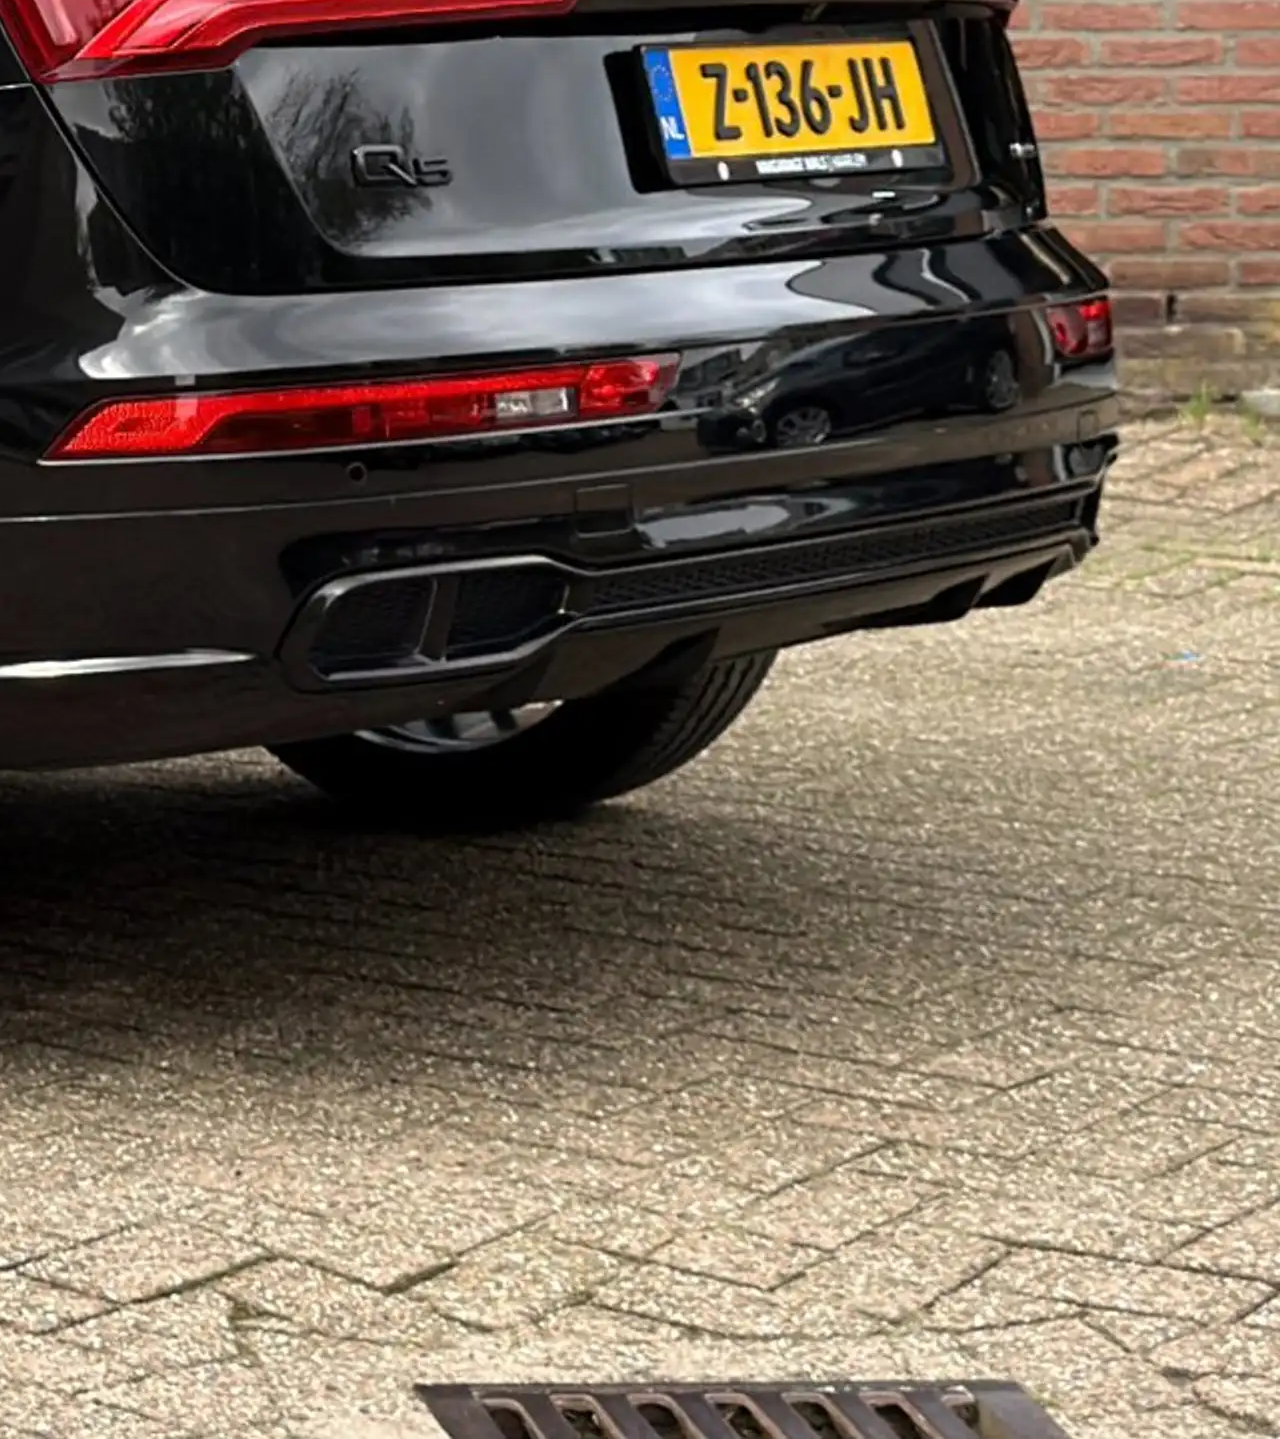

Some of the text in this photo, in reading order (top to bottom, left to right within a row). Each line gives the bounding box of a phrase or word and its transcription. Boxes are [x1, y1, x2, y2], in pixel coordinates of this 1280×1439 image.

[699, 57, 905, 142] Z-136-JH
[659, 116, 685, 141] NL
[351, 144, 454, 188] Q5
